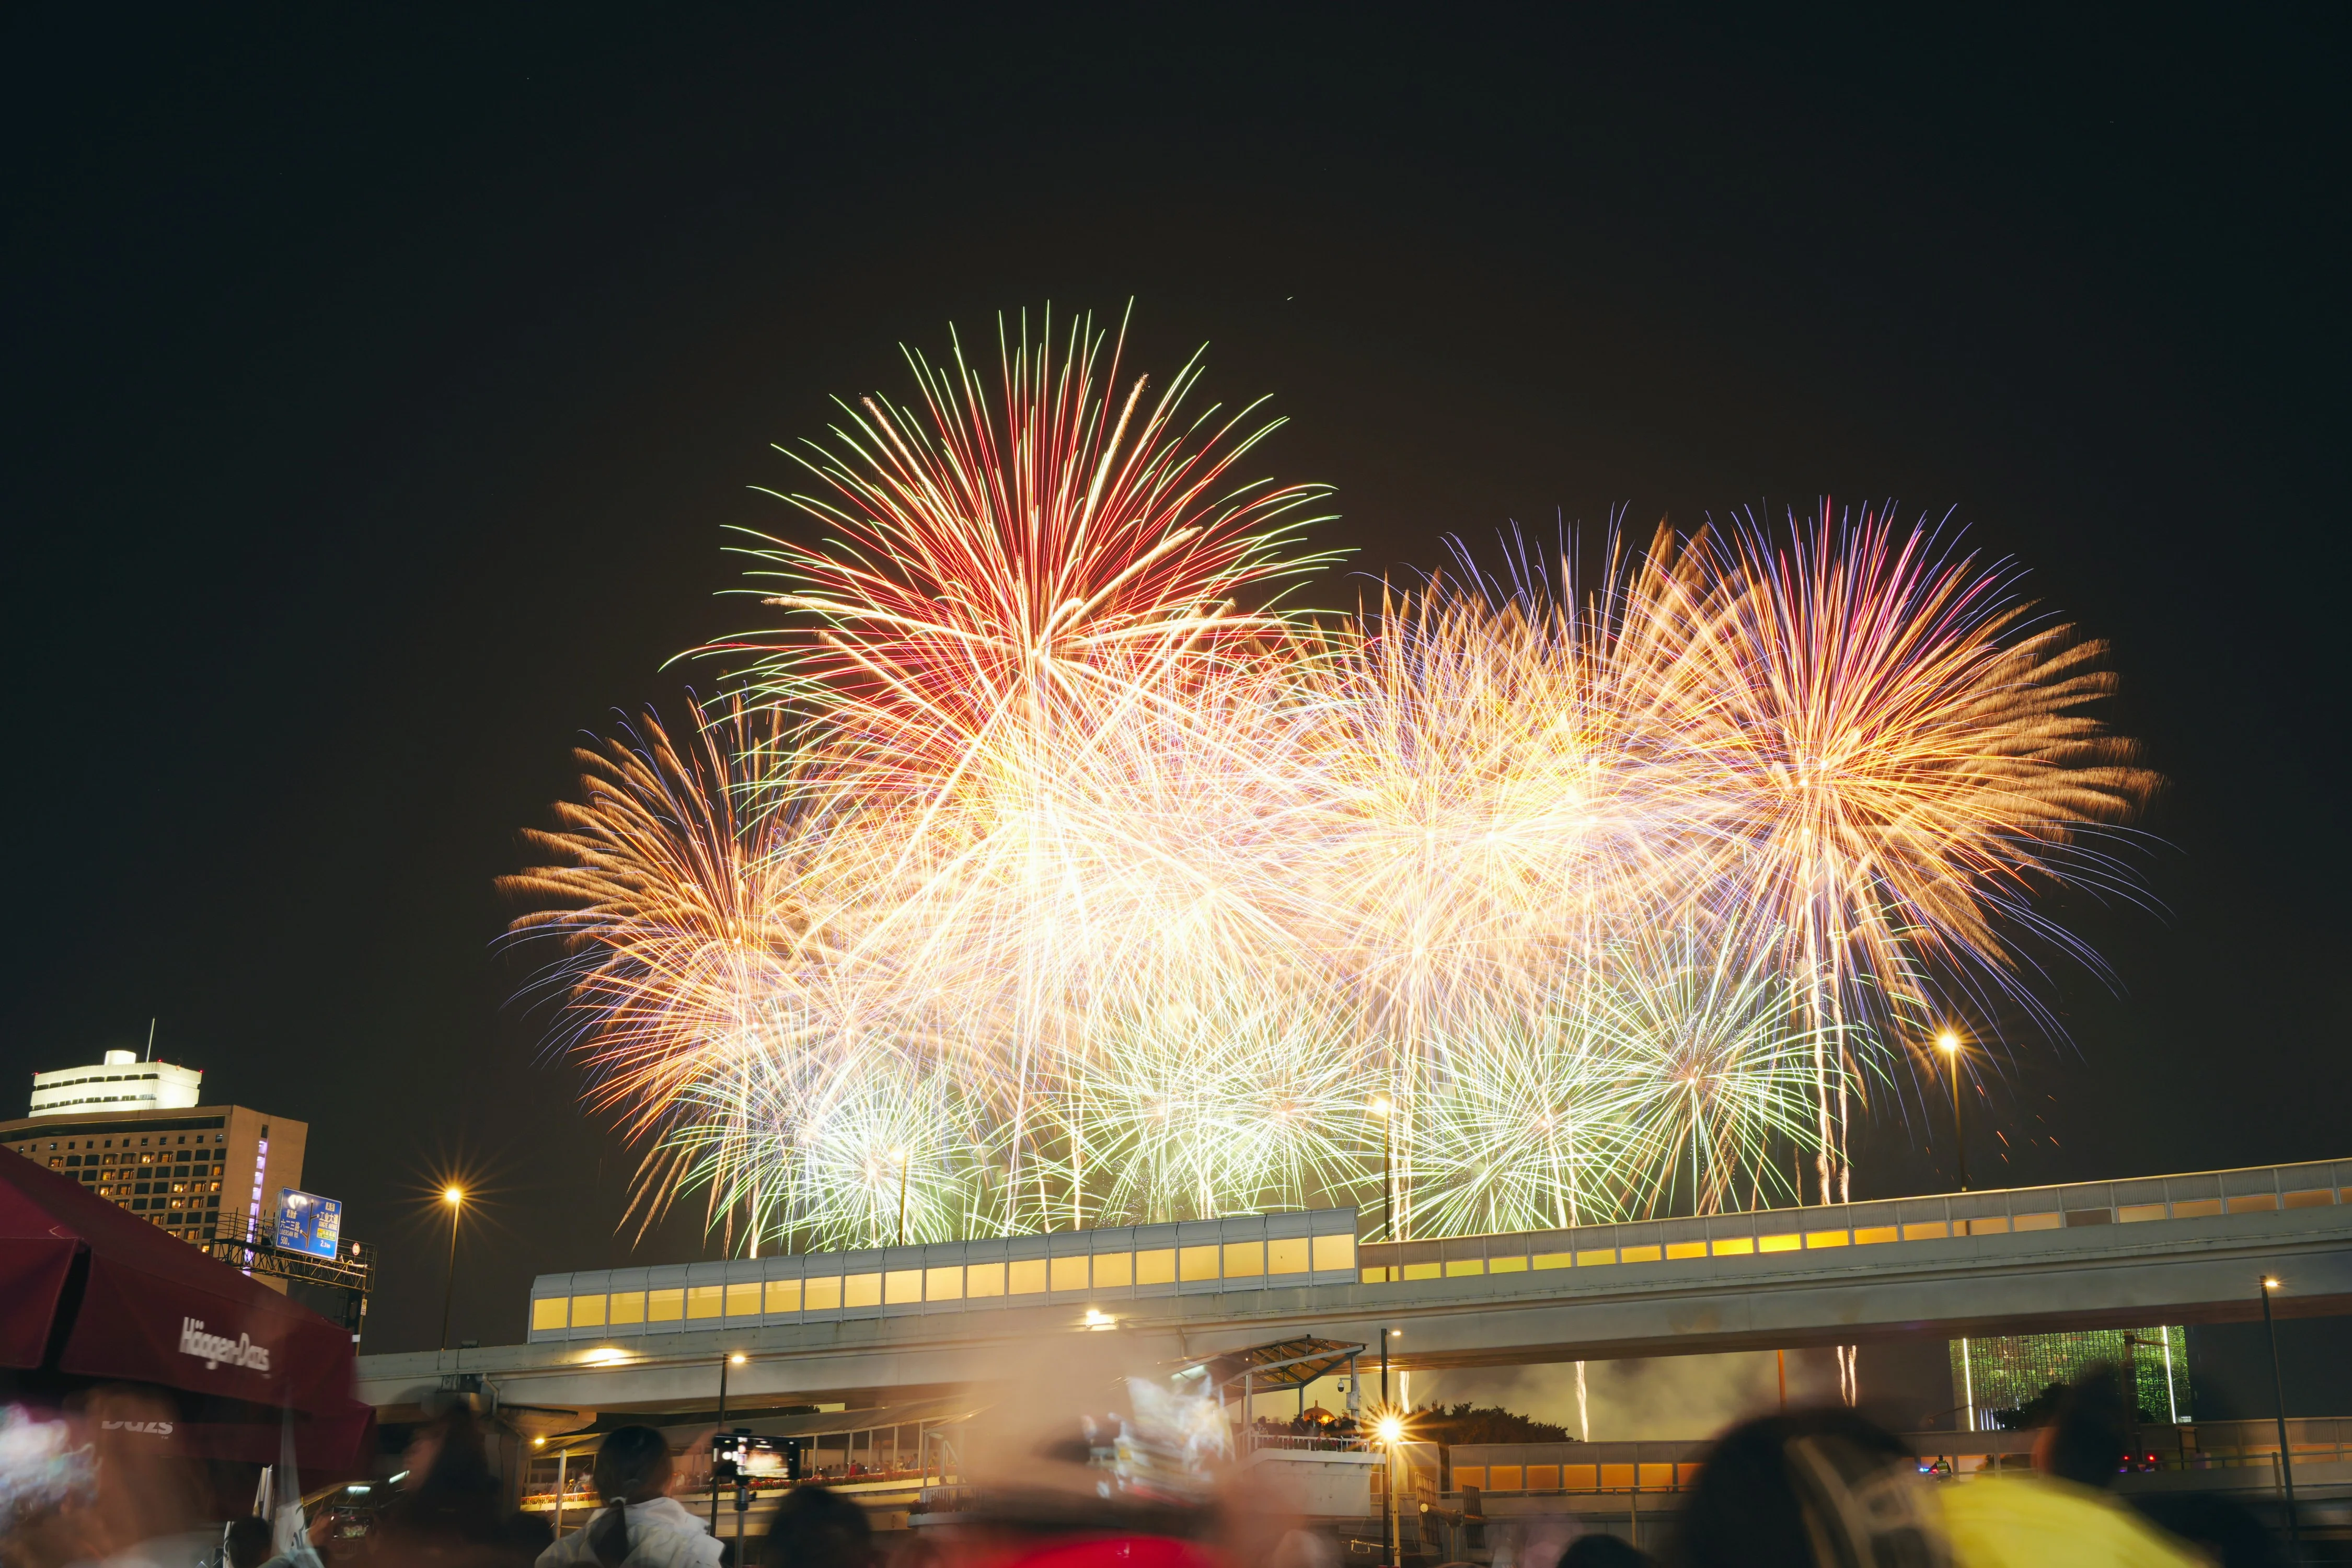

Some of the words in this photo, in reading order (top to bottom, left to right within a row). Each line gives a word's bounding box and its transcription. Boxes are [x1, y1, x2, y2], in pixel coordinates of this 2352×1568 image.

[319, 1212, 338, 1225] 工业大道
[280, 1219, 299, 1232] 六二三路
[180, 1317, 269, 1371] Häagen-Dazs
